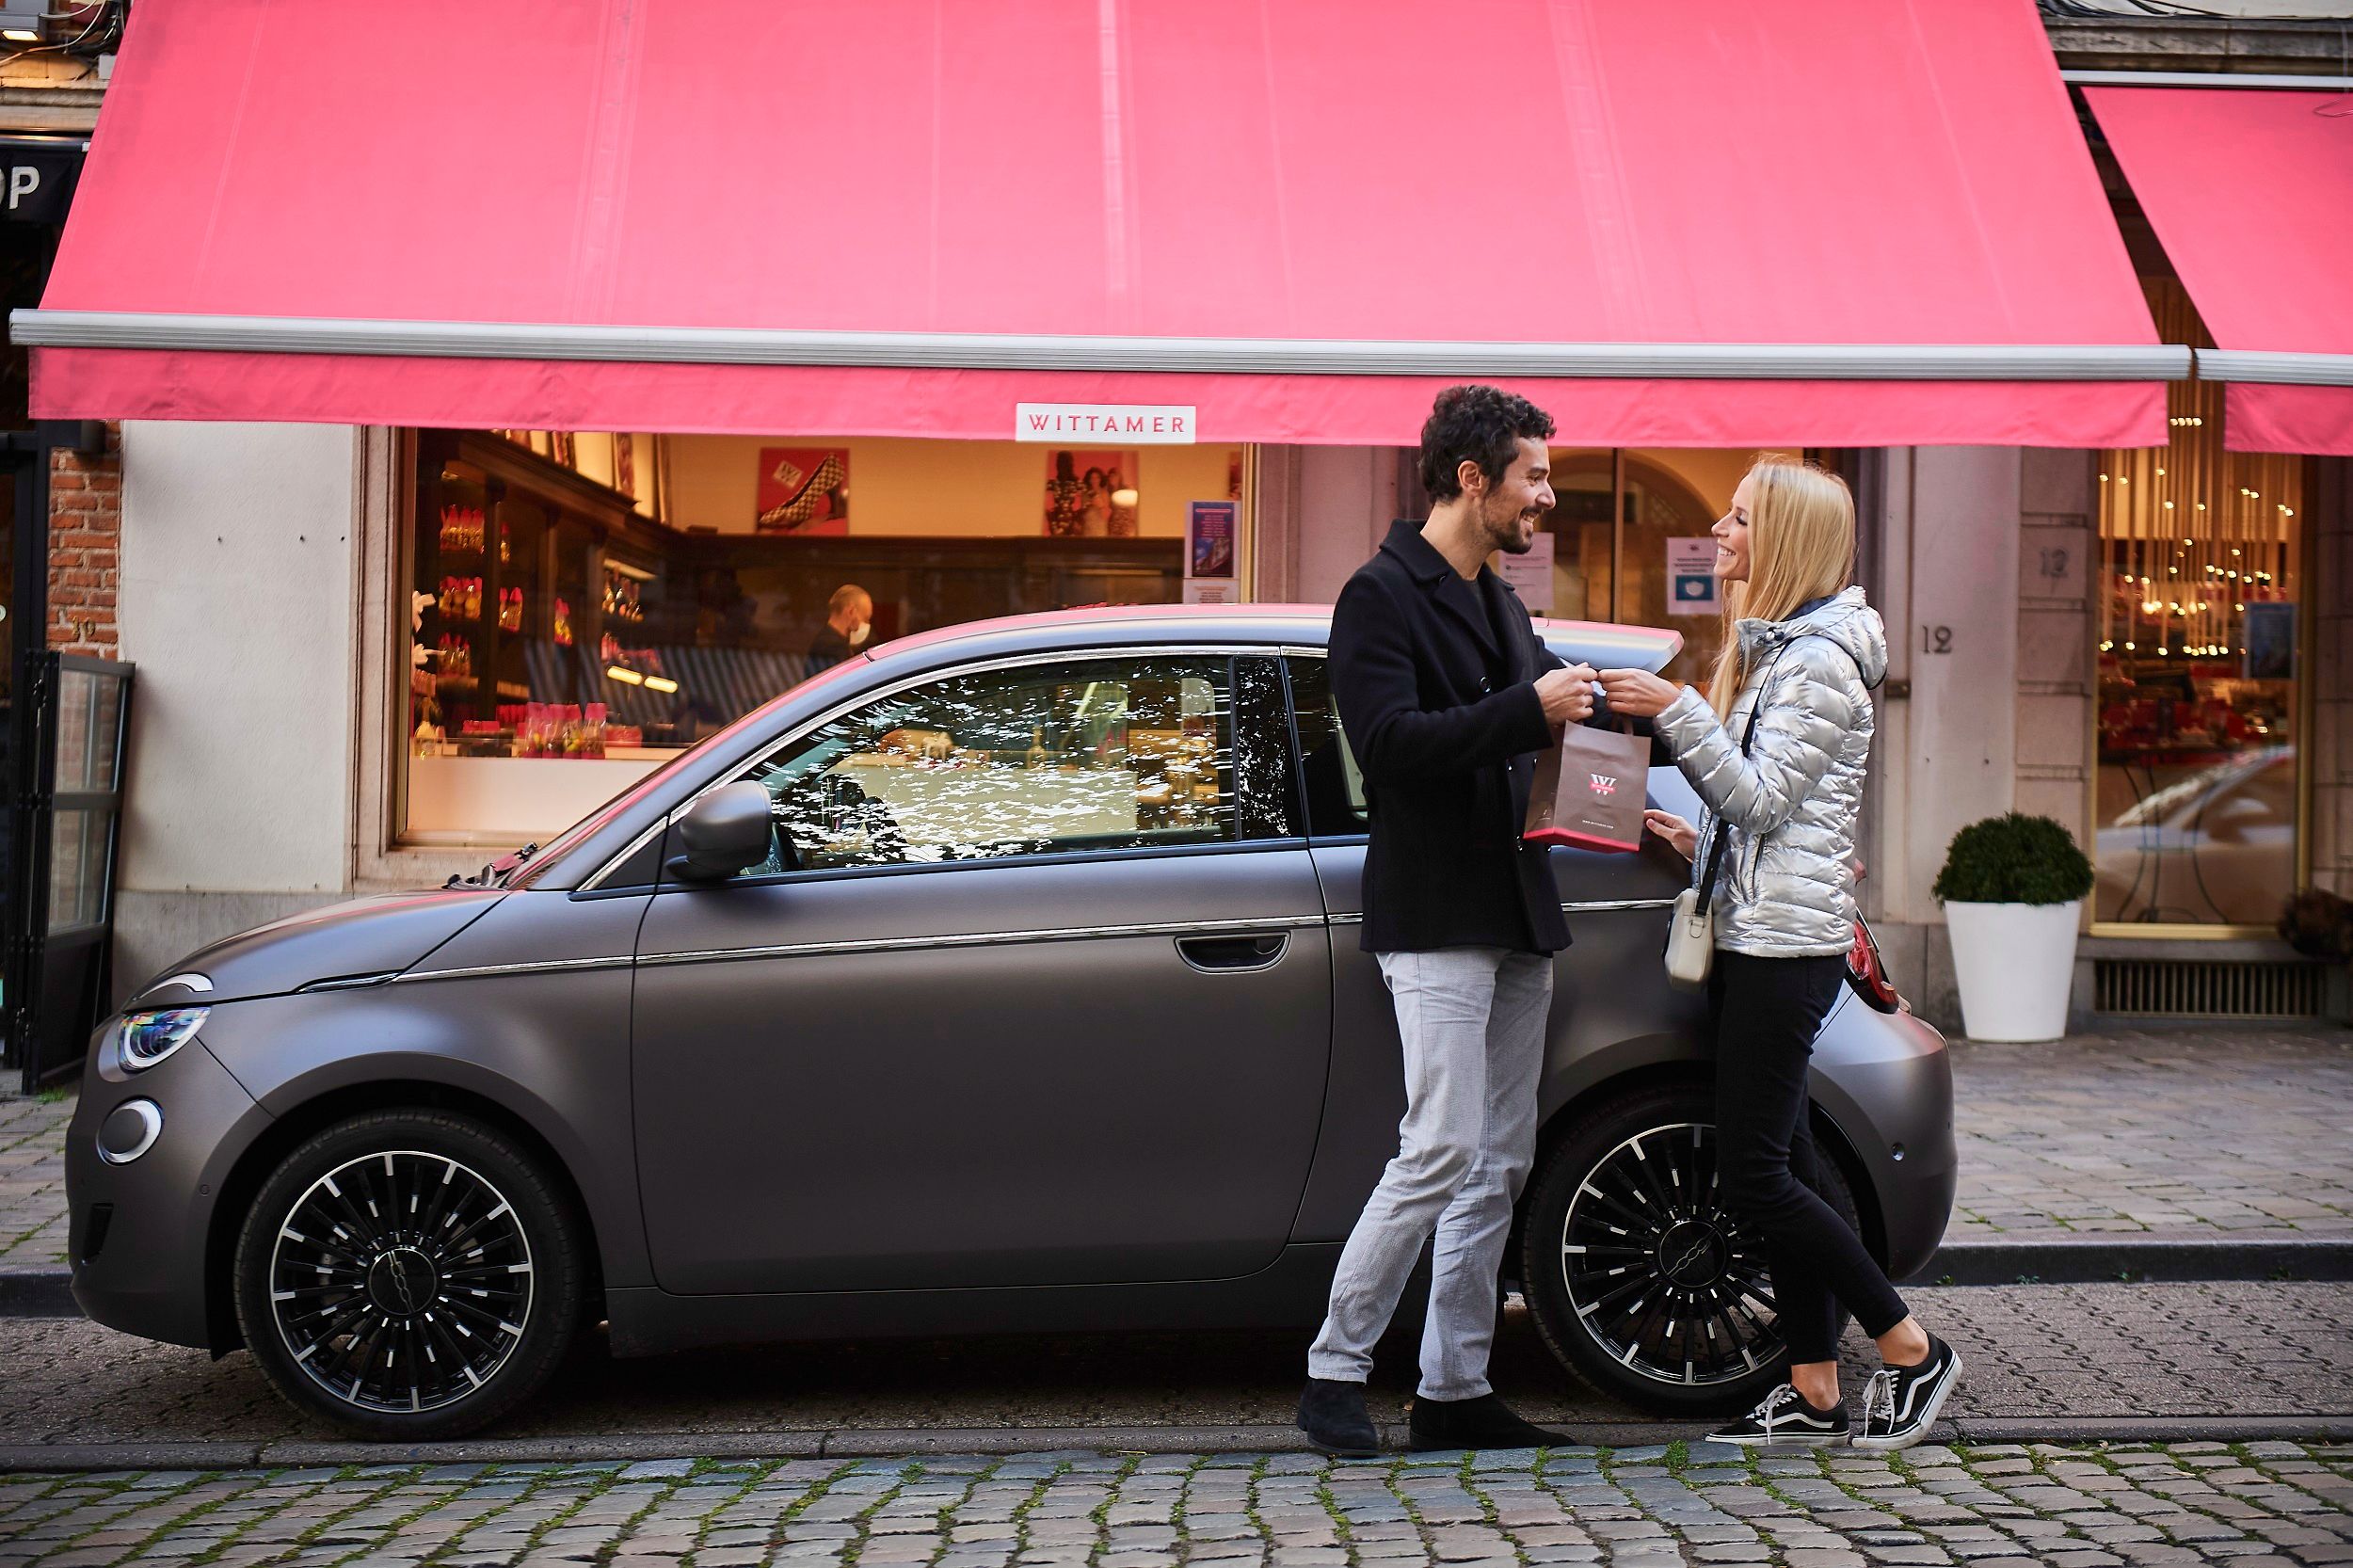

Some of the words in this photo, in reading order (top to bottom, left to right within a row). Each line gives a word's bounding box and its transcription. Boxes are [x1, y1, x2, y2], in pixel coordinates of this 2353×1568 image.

[0, 166, 40, 209] P
[1028, 413, 1184, 433] WITTAMER
[2039, 545, 2069, 579] 12
[1922, 624, 1952, 654] 12
